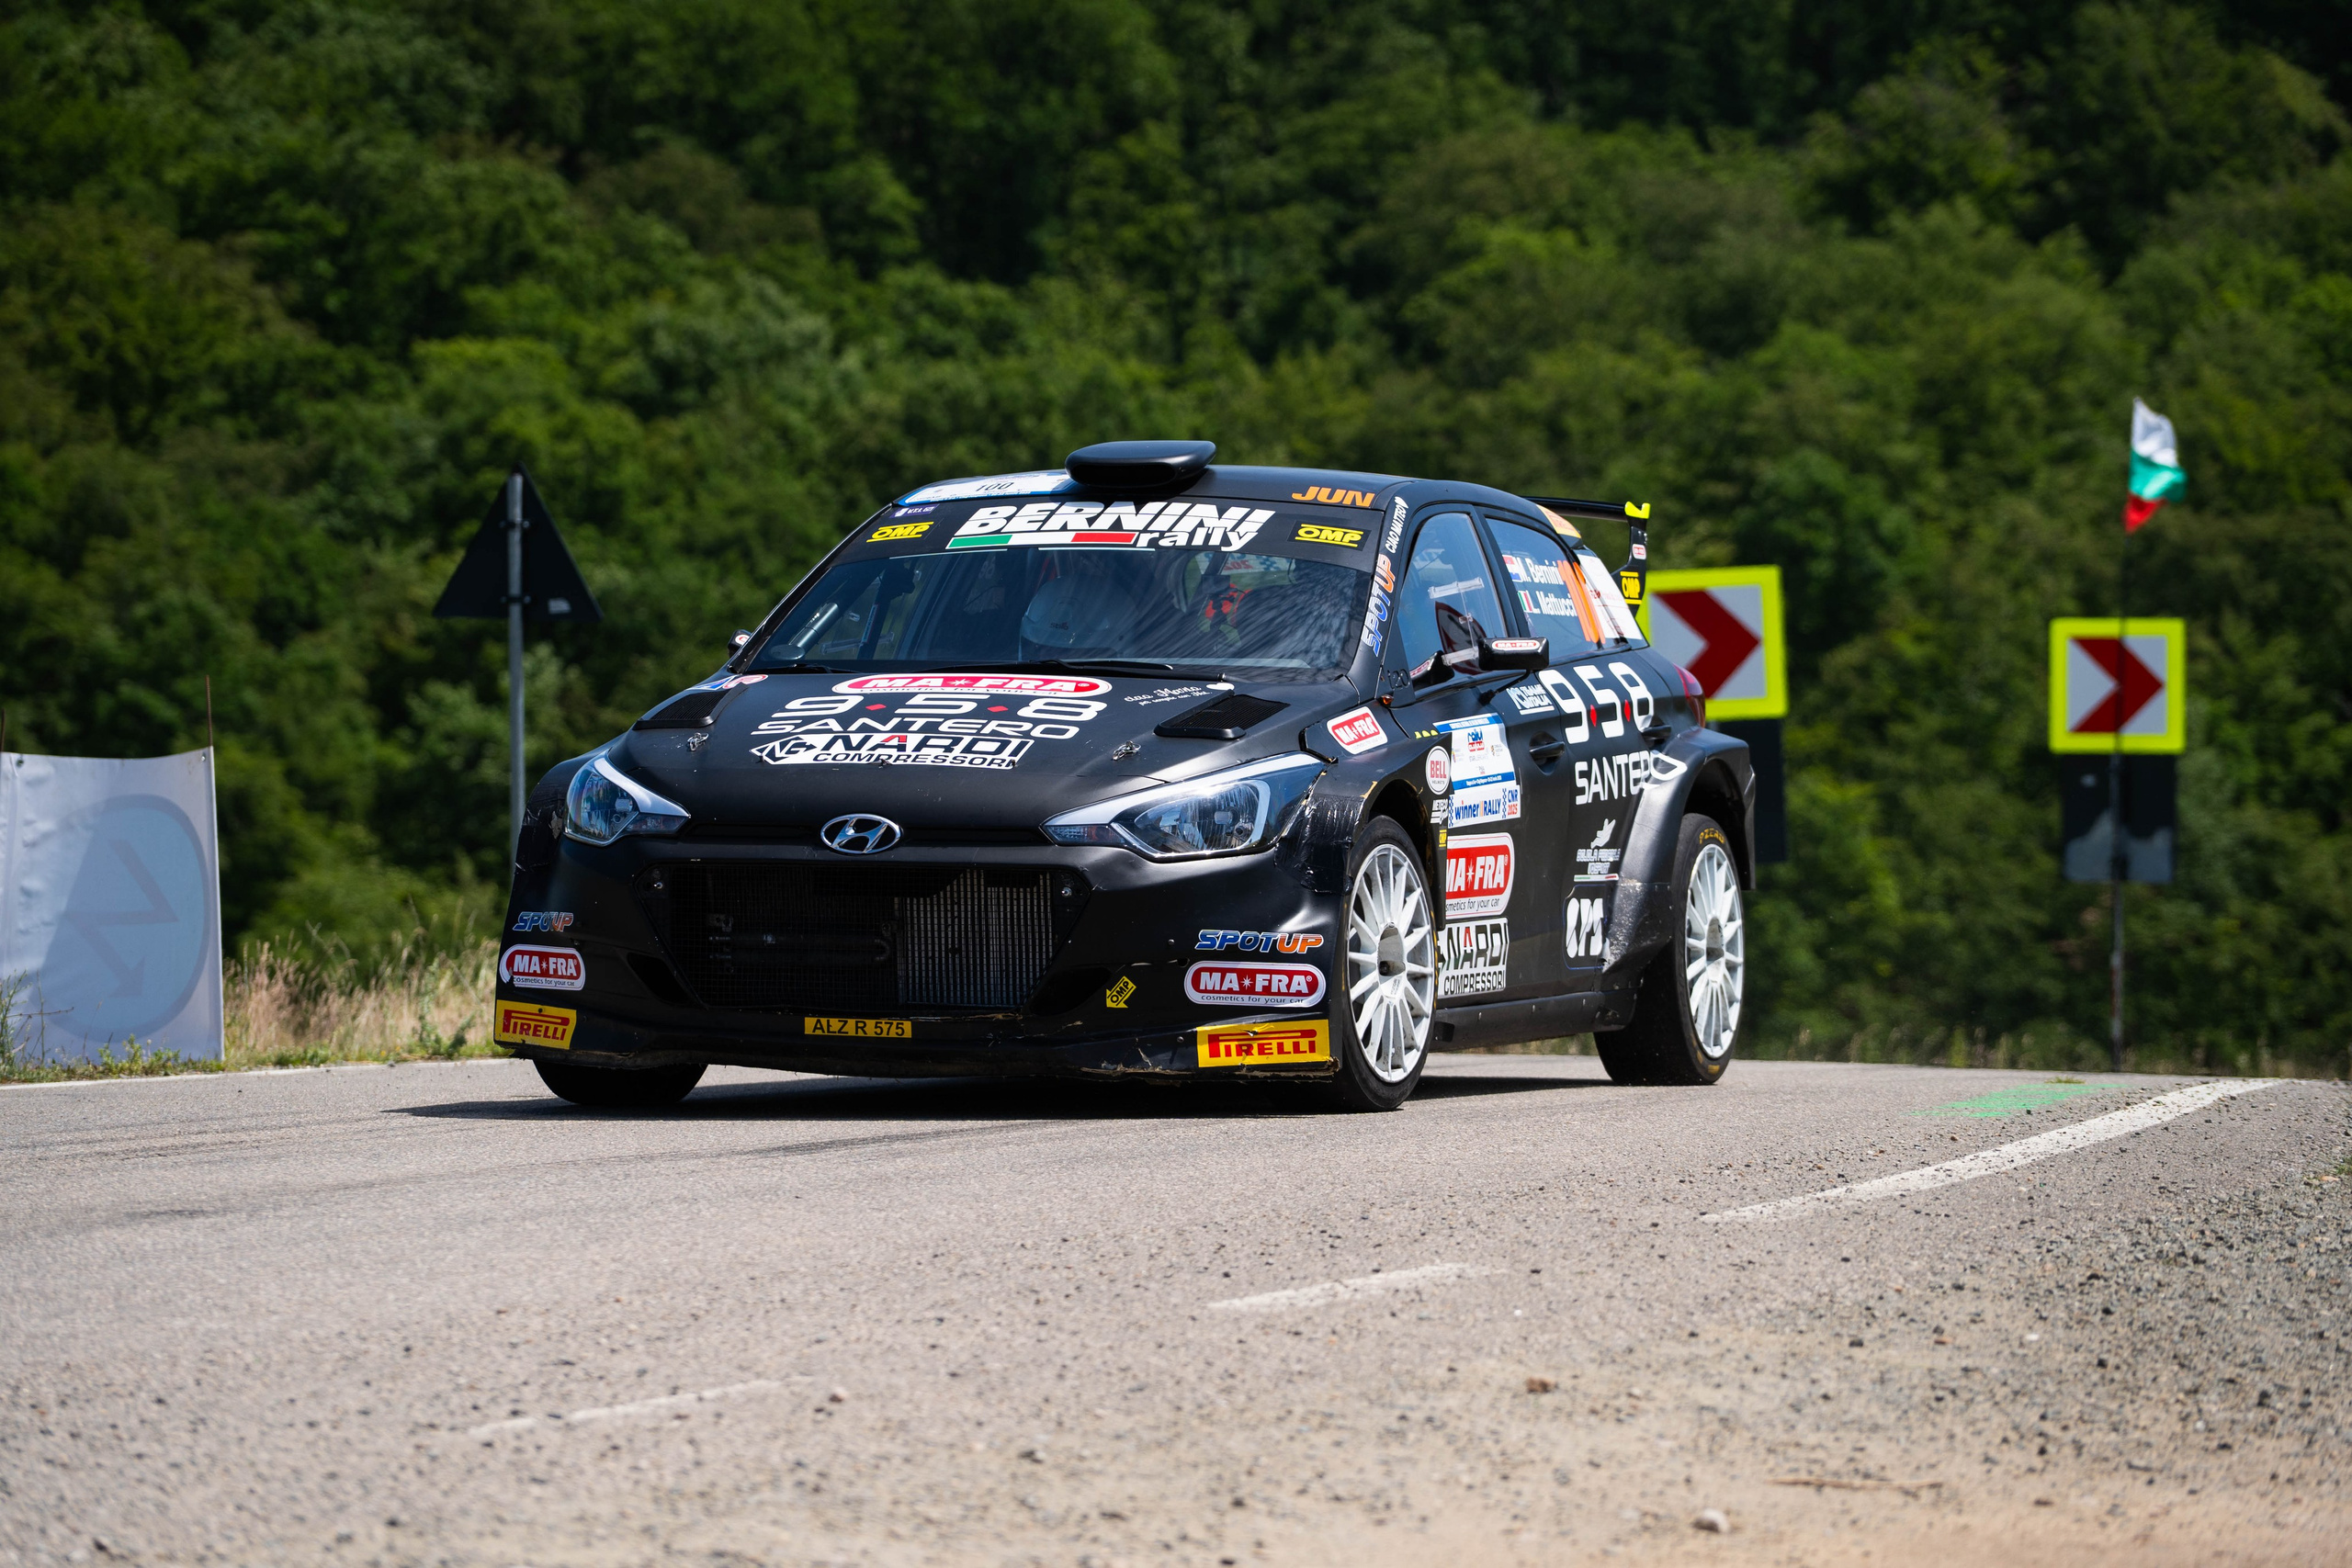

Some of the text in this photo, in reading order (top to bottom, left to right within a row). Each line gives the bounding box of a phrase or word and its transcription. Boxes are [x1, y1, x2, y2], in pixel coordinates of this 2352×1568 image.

[976, 481, 1014, 492] 100
[1291, 486, 1375, 508] JUN
[954, 501, 1276, 536] BERNINI
[1385, 502, 1408, 554] CIAO MATTEO
[871, 523, 931, 540] OMP
[1136, 525, 1259, 552] rally
[1297, 527, 1362, 544] OMP
[1525, 558, 1564, 585] Bernini
[1622, 577, 1641, 599] OMP
[1361, 553, 1396, 658] SPOTUP
[1536, 590, 1578, 616] Mattucci
[750, 717, 1081, 740] SANTERO
[820, 734, 1033, 757] NARDI
[1430, 760, 1447, 779] BELL
[1508, 789, 1518, 804] CNR
[1454, 800, 1480, 820] winner
[1484, 798, 1501, 816] RALLY
[1508, 803, 1518, 816] 2025
[1445, 897, 1500, 912] smetics for your car
[1194, 929, 1325, 953] SPOTUP
[1446, 922, 1508, 971] NARDI
[514, 976, 544, 985] cosmetics
[553, 979, 566, 987] your
[1109, 979, 1132, 1005] OMP
[1443, 970, 1505, 996] COMPRESSORI
[503, 1009, 571, 1042] PIRELLI
[812, 1018, 906, 1037] ALZ R 575
[1207, 1028, 1317, 1059] PIRELLI
